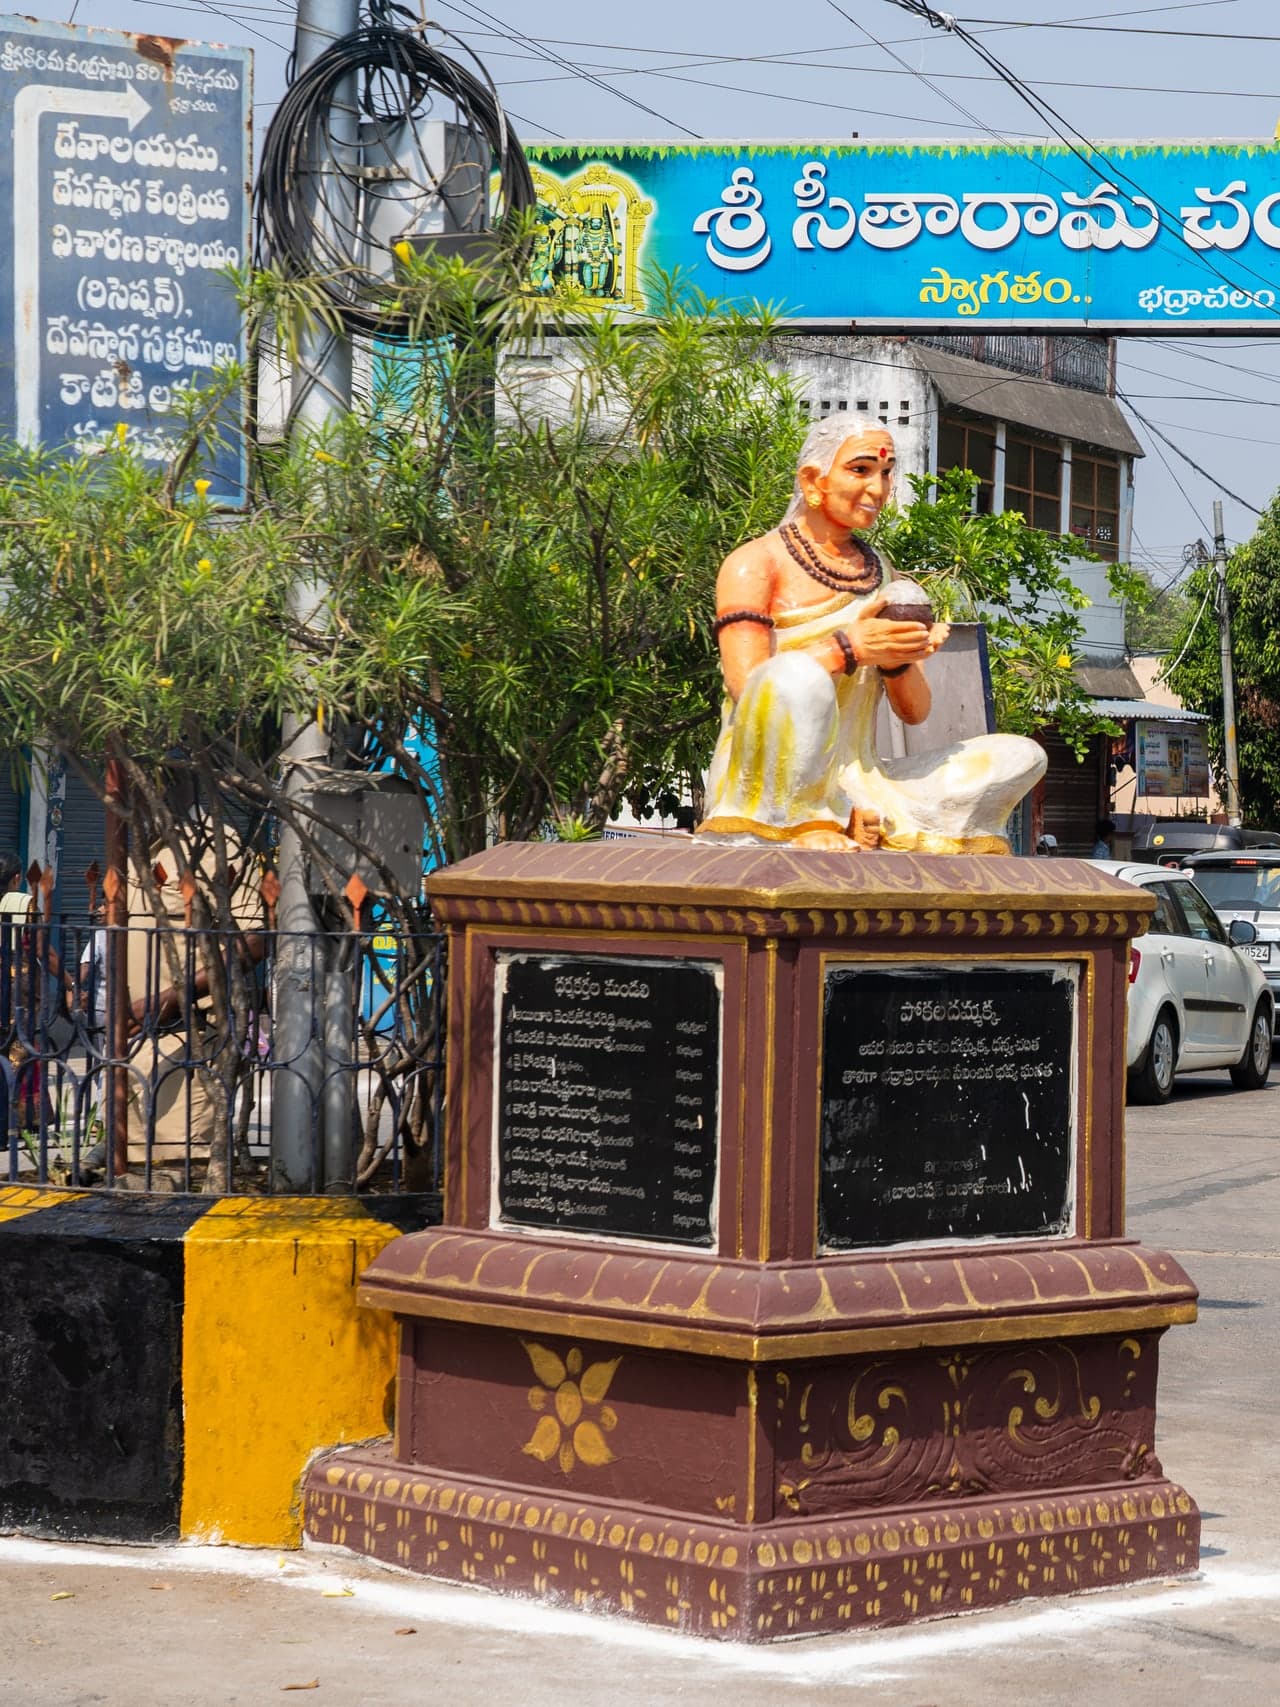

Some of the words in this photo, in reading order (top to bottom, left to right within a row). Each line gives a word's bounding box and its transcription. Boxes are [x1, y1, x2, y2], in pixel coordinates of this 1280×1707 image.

[52, 167, 141, 219] దేవస్థాన
[145, 179, 230, 225] కేంద్రీయ
[693, 166, 772, 272] శ్రీ
[792, 161, 1160, 250] సీతారామ
[52, 224, 143, 262] విచారణ
[1138, 284, 1275, 316] భద్రాచలం
[46, 315, 140, 362] దేవస్థాన
